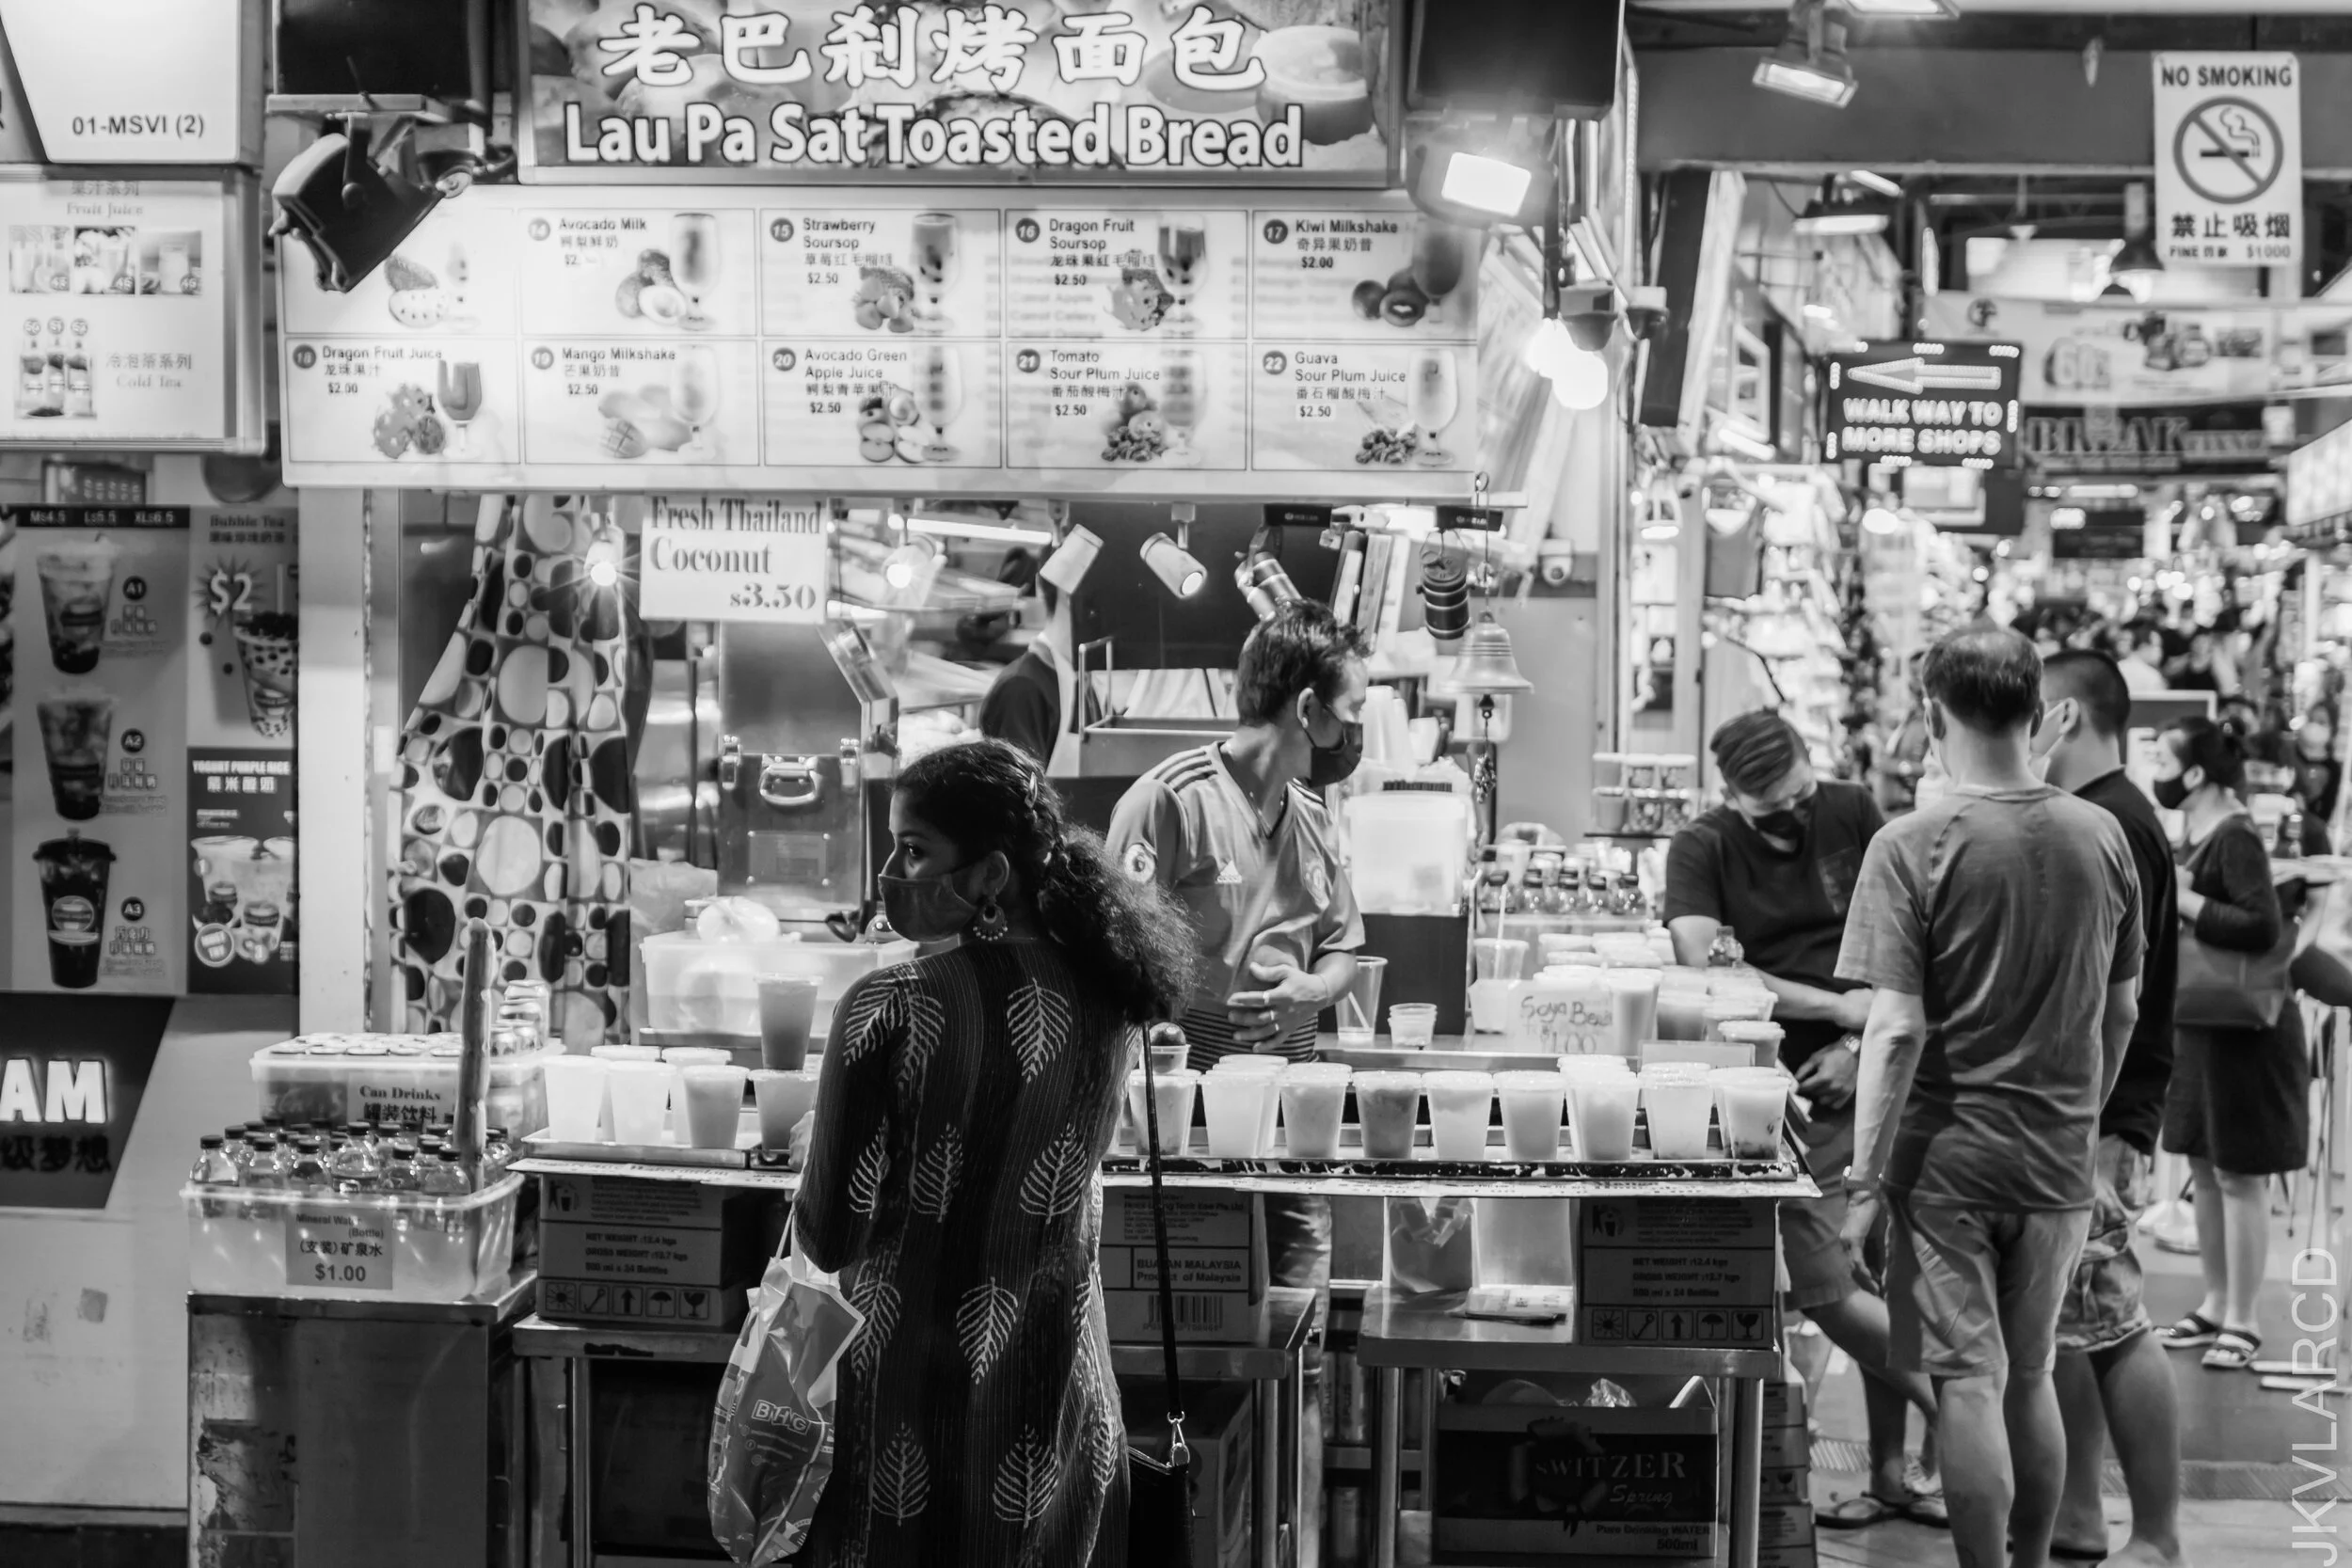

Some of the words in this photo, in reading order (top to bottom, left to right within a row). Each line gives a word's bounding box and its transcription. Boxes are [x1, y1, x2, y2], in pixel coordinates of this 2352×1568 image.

[2162, 66, 2189, 87] NO
[2198, 66, 2292, 87] SMOKING
[72, 116, 168, 135] 01-MSVI
[177, 114, 205, 138] (2)
[564, 103, 671, 164] Lau
[685, 103, 756, 165] Pa
[769, 103, 868, 165] Sat
[875, 102, 1112, 166] Toasted
[1127, 104, 1304, 166] Bread
[560, 217, 615, 230] Avocado
[621, 217, 647, 230] Milk
[773, 224, 791, 236] 15
[803, 217, 875, 233] Strawberry
[1049, 218, 1098, 234] Dragon
[1104, 218, 1135, 231] Fruit
[1295, 220, 1326, 233] Kiwi
[1329, 220, 1398, 233] Milkshake
[1019, 225, 1036, 238] 16
[1265, 226, 1284, 239] 17
[803, 236, 859, 251] Soursop
[1050, 236, 1106, 251] Soursop
[1301, 257, 1333, 269] $2.00
[808, 273, 838, 285] $2.50
[1055, 274, 1087, 286] $2.50
[323, 345, 369, 361] Dragon
[374, 346, 404, 359] Fruit
[410, 347, 442, 359] Juice
[563, 348, 605, 363] Mango
[611, 348, 676, 361] Milkshake
[805, 349, 862, 361] Avocado
[867, 349, 907, 362] Green
[1050, 350, 1100, 363] Tomato
[1295, 352, 1338, 365] Guava
[774, 355, 792, 367] 20
[1019, 356, 1036, 368] 21
[1264, 356, 1284, 370] 22
[805, 366, 843, 380] Apple
[849, 366, 882, 378] Juice
[1050, 368, 1082, 380] Sour
[1087, 368, 1120, 380] Plum
[1125, 368, 1160, 380] Juice
[1295, 370, 1327, 382] Sour
[1331, 370, 1365, 382] Plum
[1370, 370, 1406, 382] Juice
[328, 382, 358, 394] $2.00
[568, 383, 598, 395] $2.50
[810, 402, 840, 414] $2.50
[1056, 404, 1087, 417] $2.50
[1300, 405, 1332, 419] $2.50
[1842, 397, 1910, 425] WALK
[1912, 399, 1966, 425] WAY
[1968, 401, 2003, 426] TO
[1917, 428, 2002, 455] SHOPS
[651, 496, 713, 531] Fresh
[720, 498, 821, 534] Thailand
[650, 535, 771, 574] Coconut
[209, 569, 253, 615] $2
[124, 735, 142, 747] A2
[124, 903, 141, 916] A3
[1521, 995, 1567, 1023] Soya
[0, 1058, 107, 1123] AM
[359, 1085, 387, 1098] Can
[392, 1086, 440, 1101] Drinks
[296, 1213, 331, 1225] Mineral
[348, 1227, 384, 1240] (Bottle)
[1137, 1259, 1182, 1270] BUAAN
[1184, 1260, 1242, 1270] MALAYSIA
[315, 1263, 366, 1281] $1.00
[1183, 1272, 1194, 1282] of
[1196, 1272, 1242, 1283] Malaysia
[754, 1400, 809, 1433] BHG
[1535, 1451, 1687, 1479] SWITZER
[1609, 1483, 1675, 1510] Spring
[1625, 1525, 1669, 1536] Drinking
[1672, 1525, 1711, 1535] WATER
[1657, 1538, 1698, 1551] 500ml
